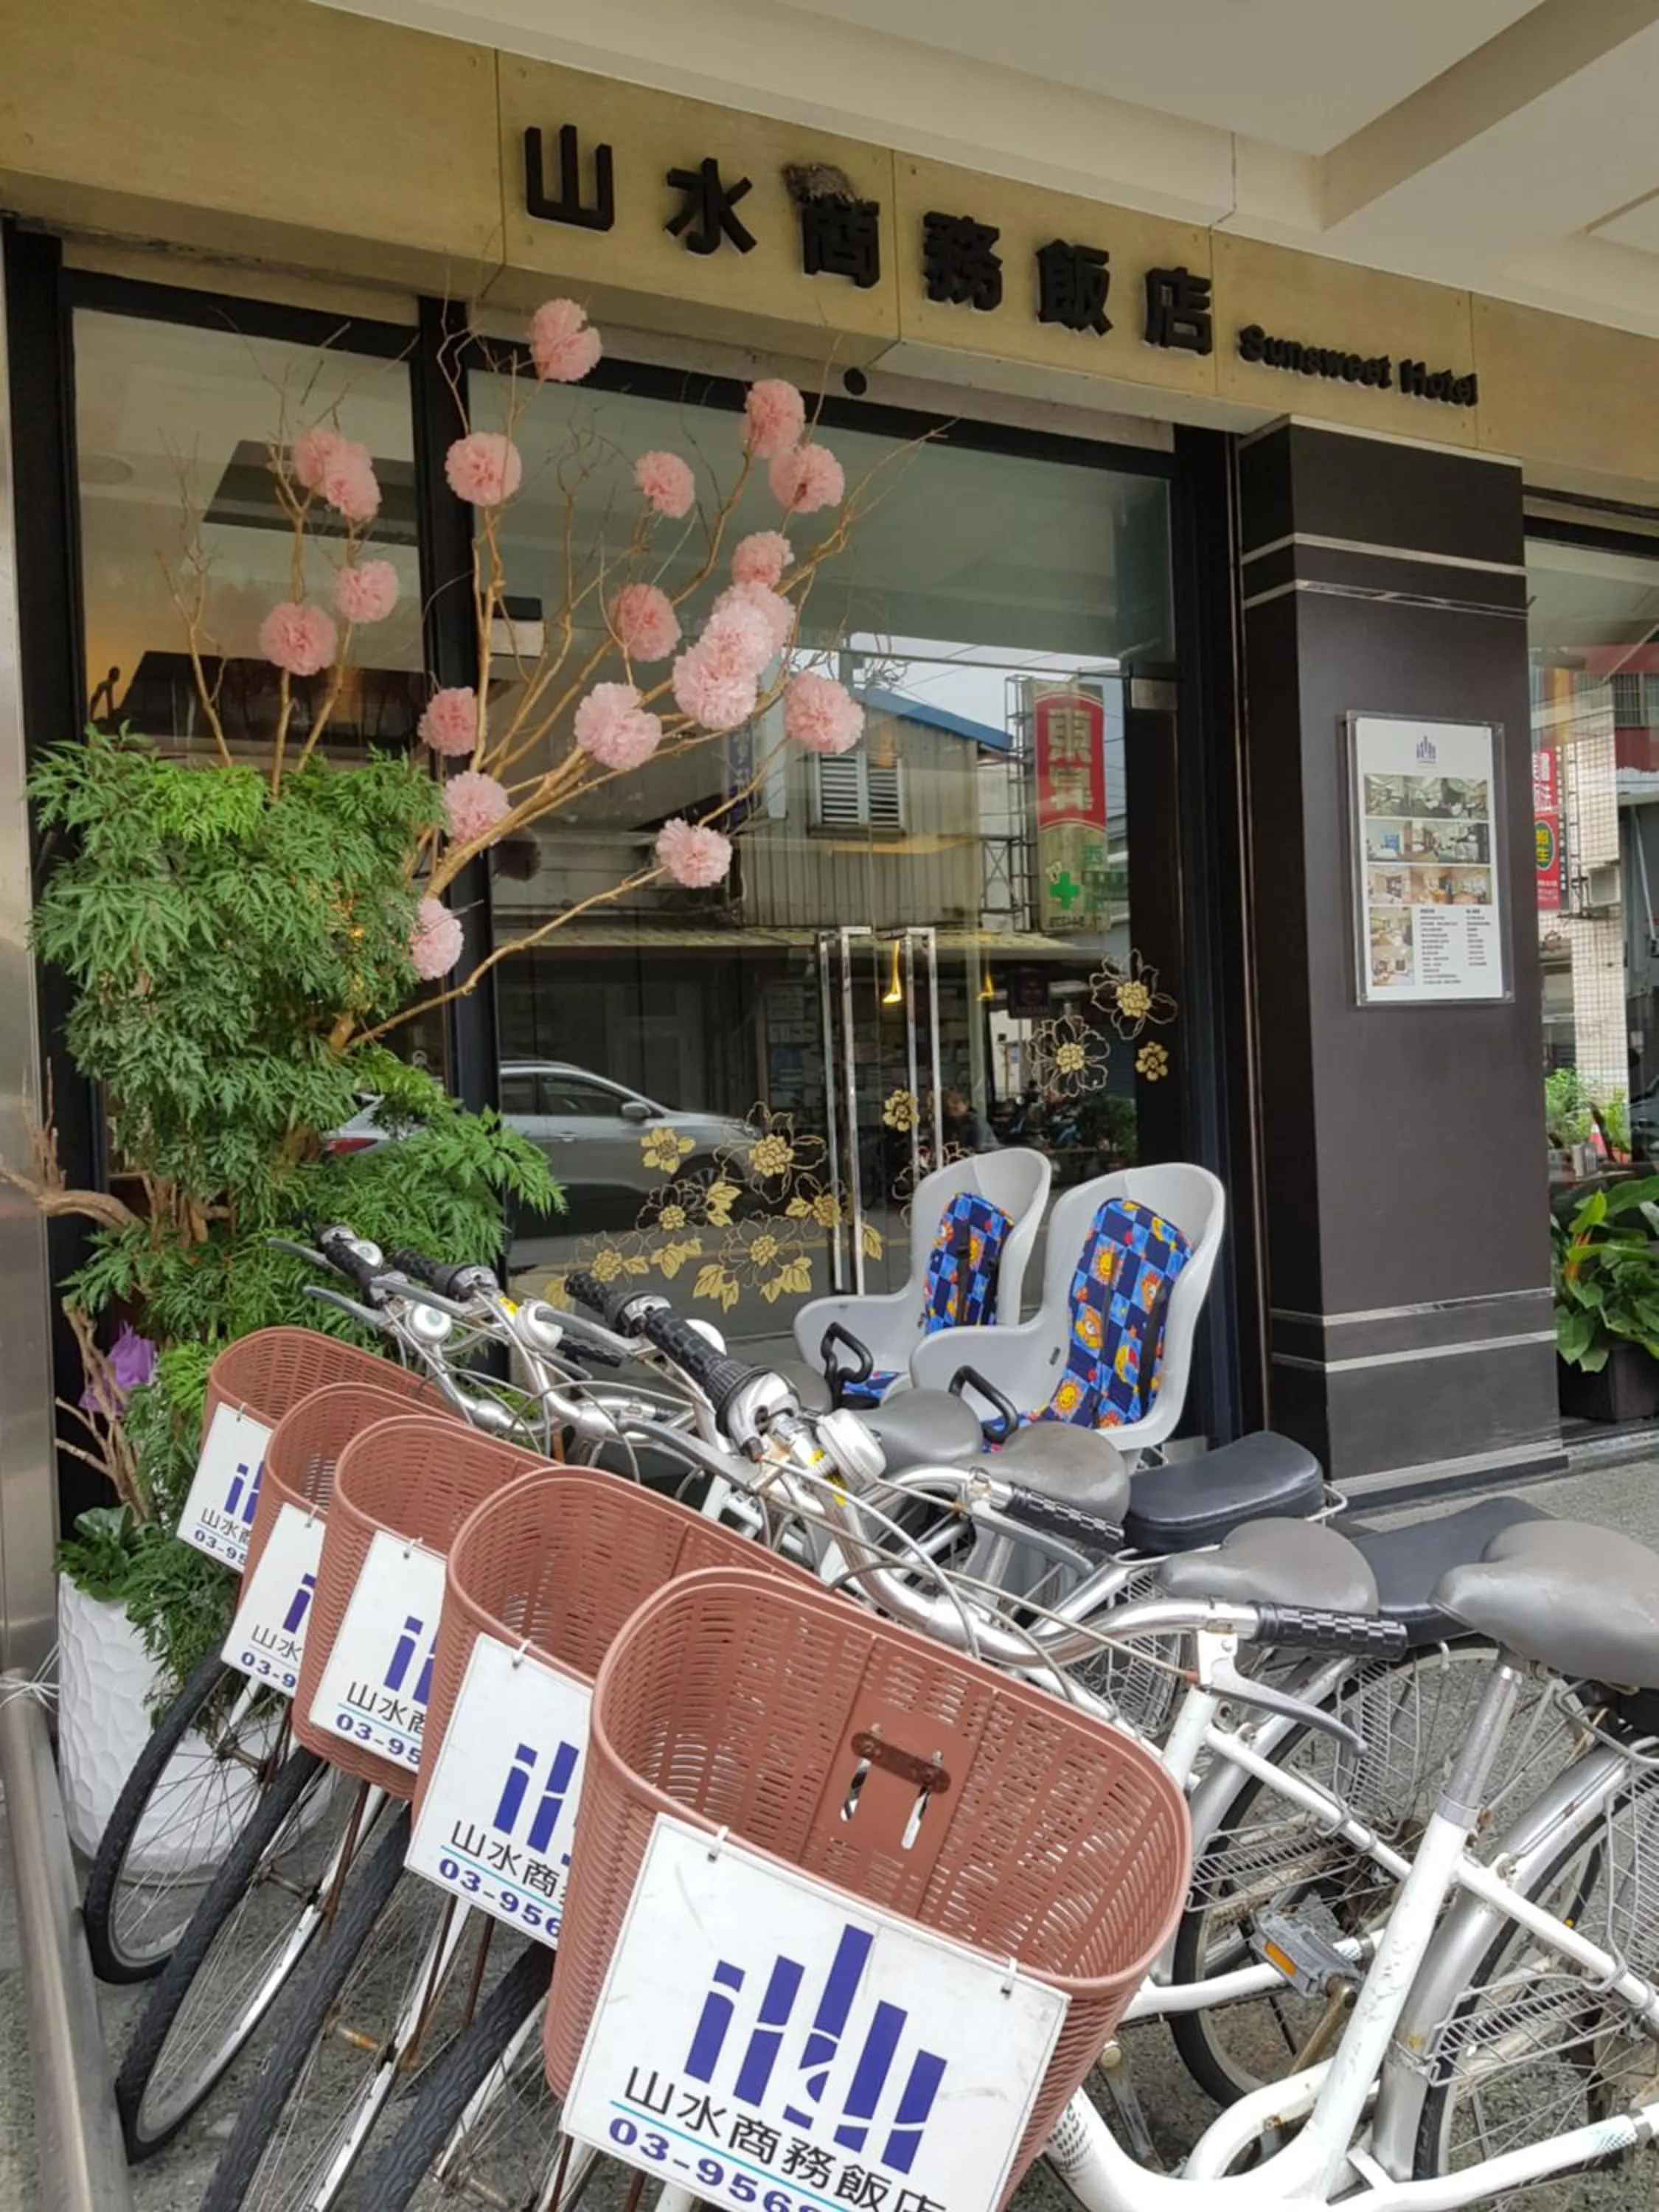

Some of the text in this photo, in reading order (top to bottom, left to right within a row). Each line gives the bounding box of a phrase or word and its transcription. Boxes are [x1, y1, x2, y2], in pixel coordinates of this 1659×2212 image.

[524, 123, 1213, 355] 山水商務飯店
[1399, 358, 1478, 407] Hotel
[240, 1651, 296, 1688] 03-9
[336, 1713, 422, 1764] 03-95
[439, 1858, 562, 1938] 03-956
[451, 1820, 567, 1906] 山水商
[608, 2117, 821, 2212] 03-956
